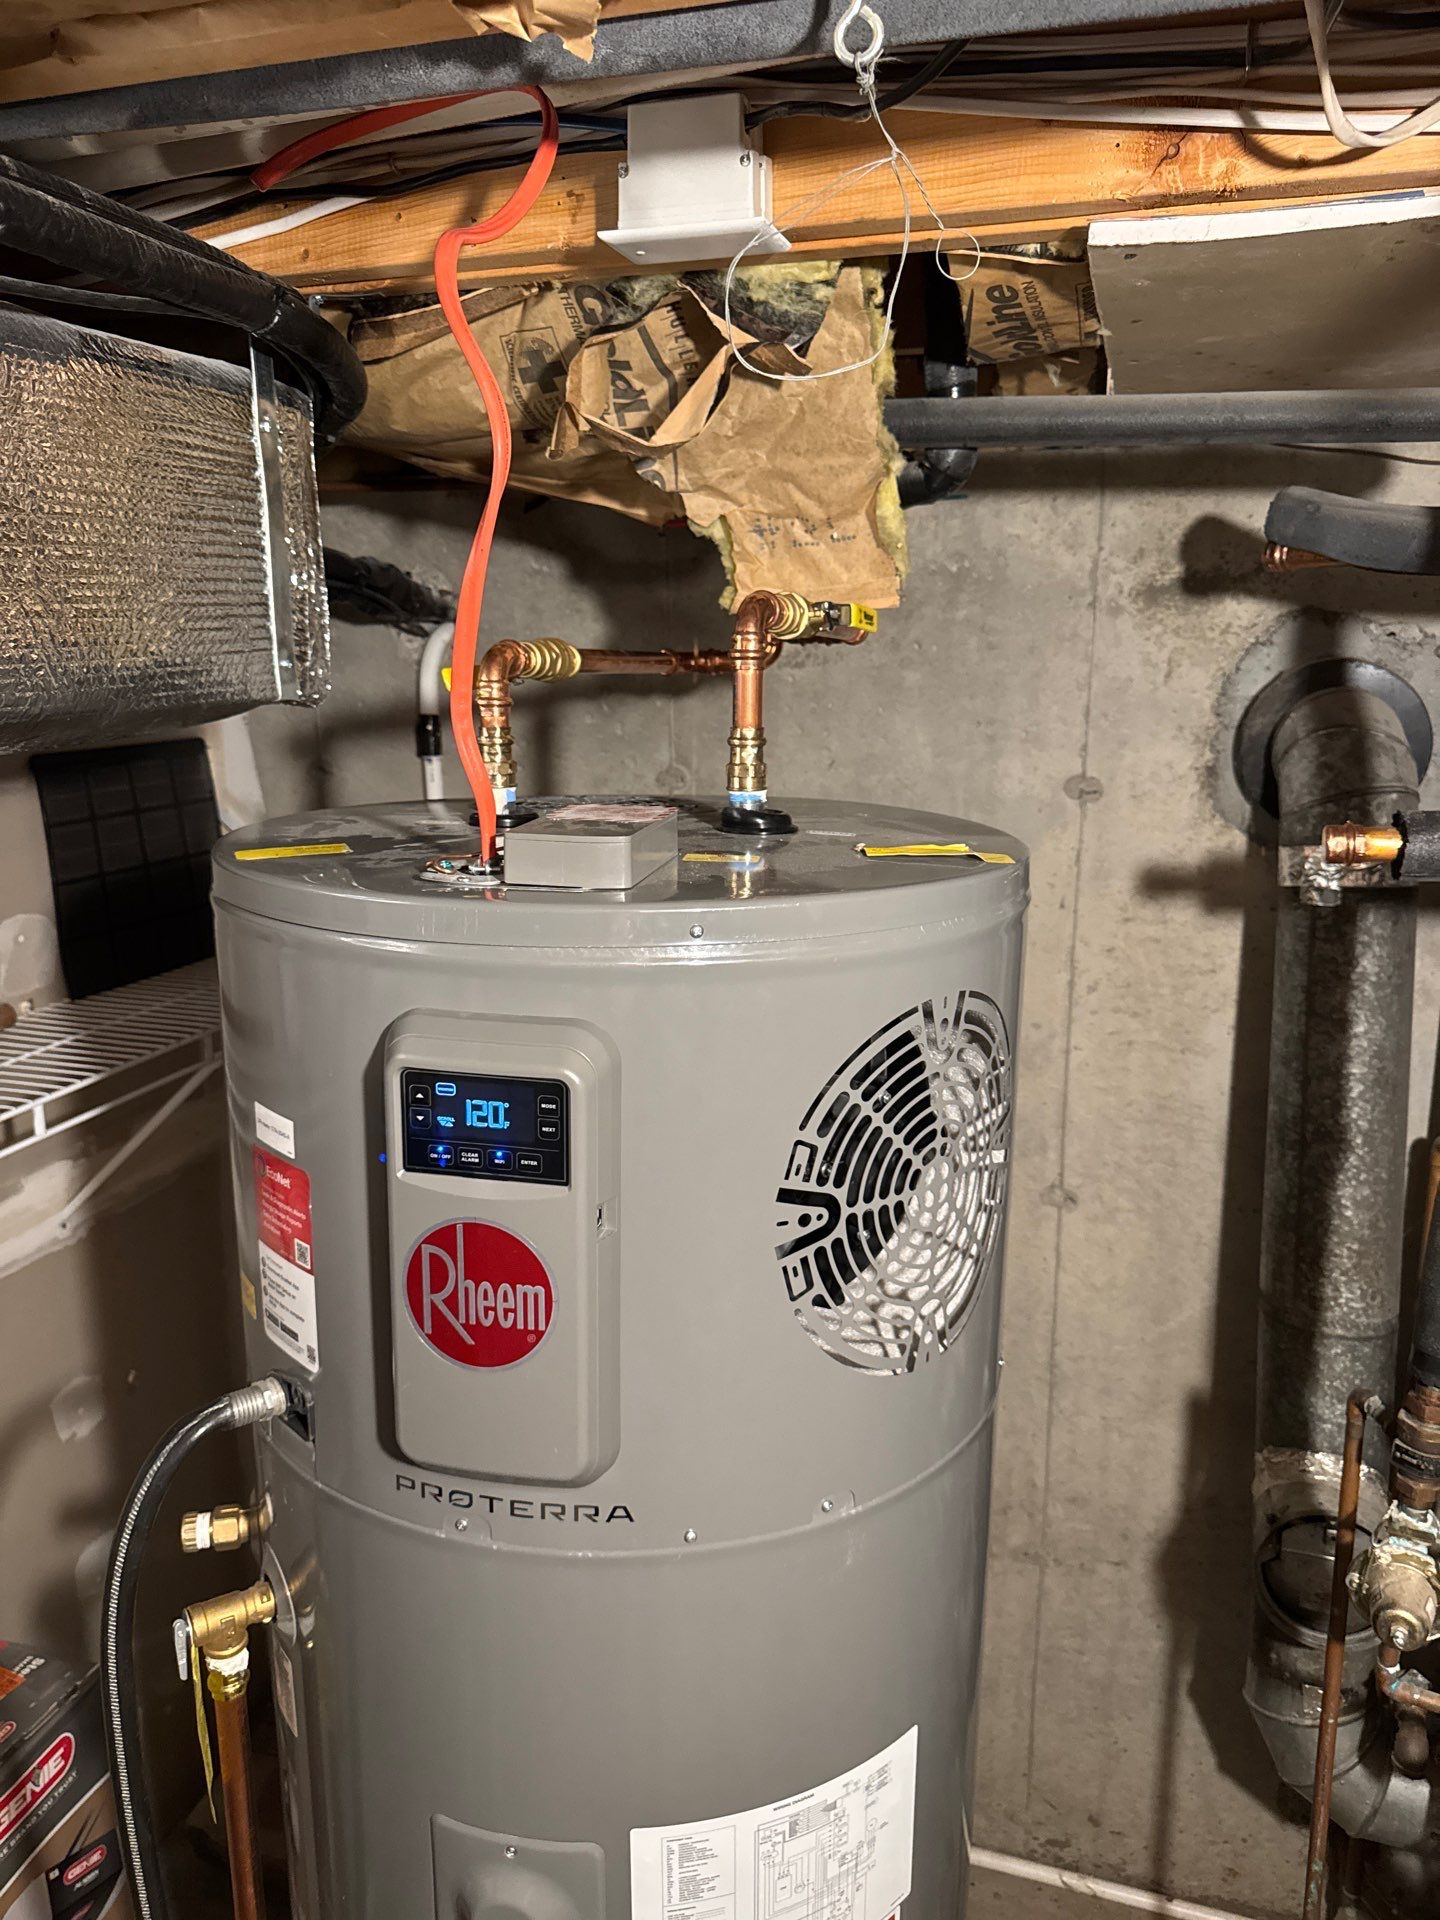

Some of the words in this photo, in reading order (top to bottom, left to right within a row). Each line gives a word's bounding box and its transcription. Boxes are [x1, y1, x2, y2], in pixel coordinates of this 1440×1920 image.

[265, 1165, 291, 1190] EcoNet
[421, 1223, 546, 1346] Rheem
[67, 1849, 102, 1880] GENIE
